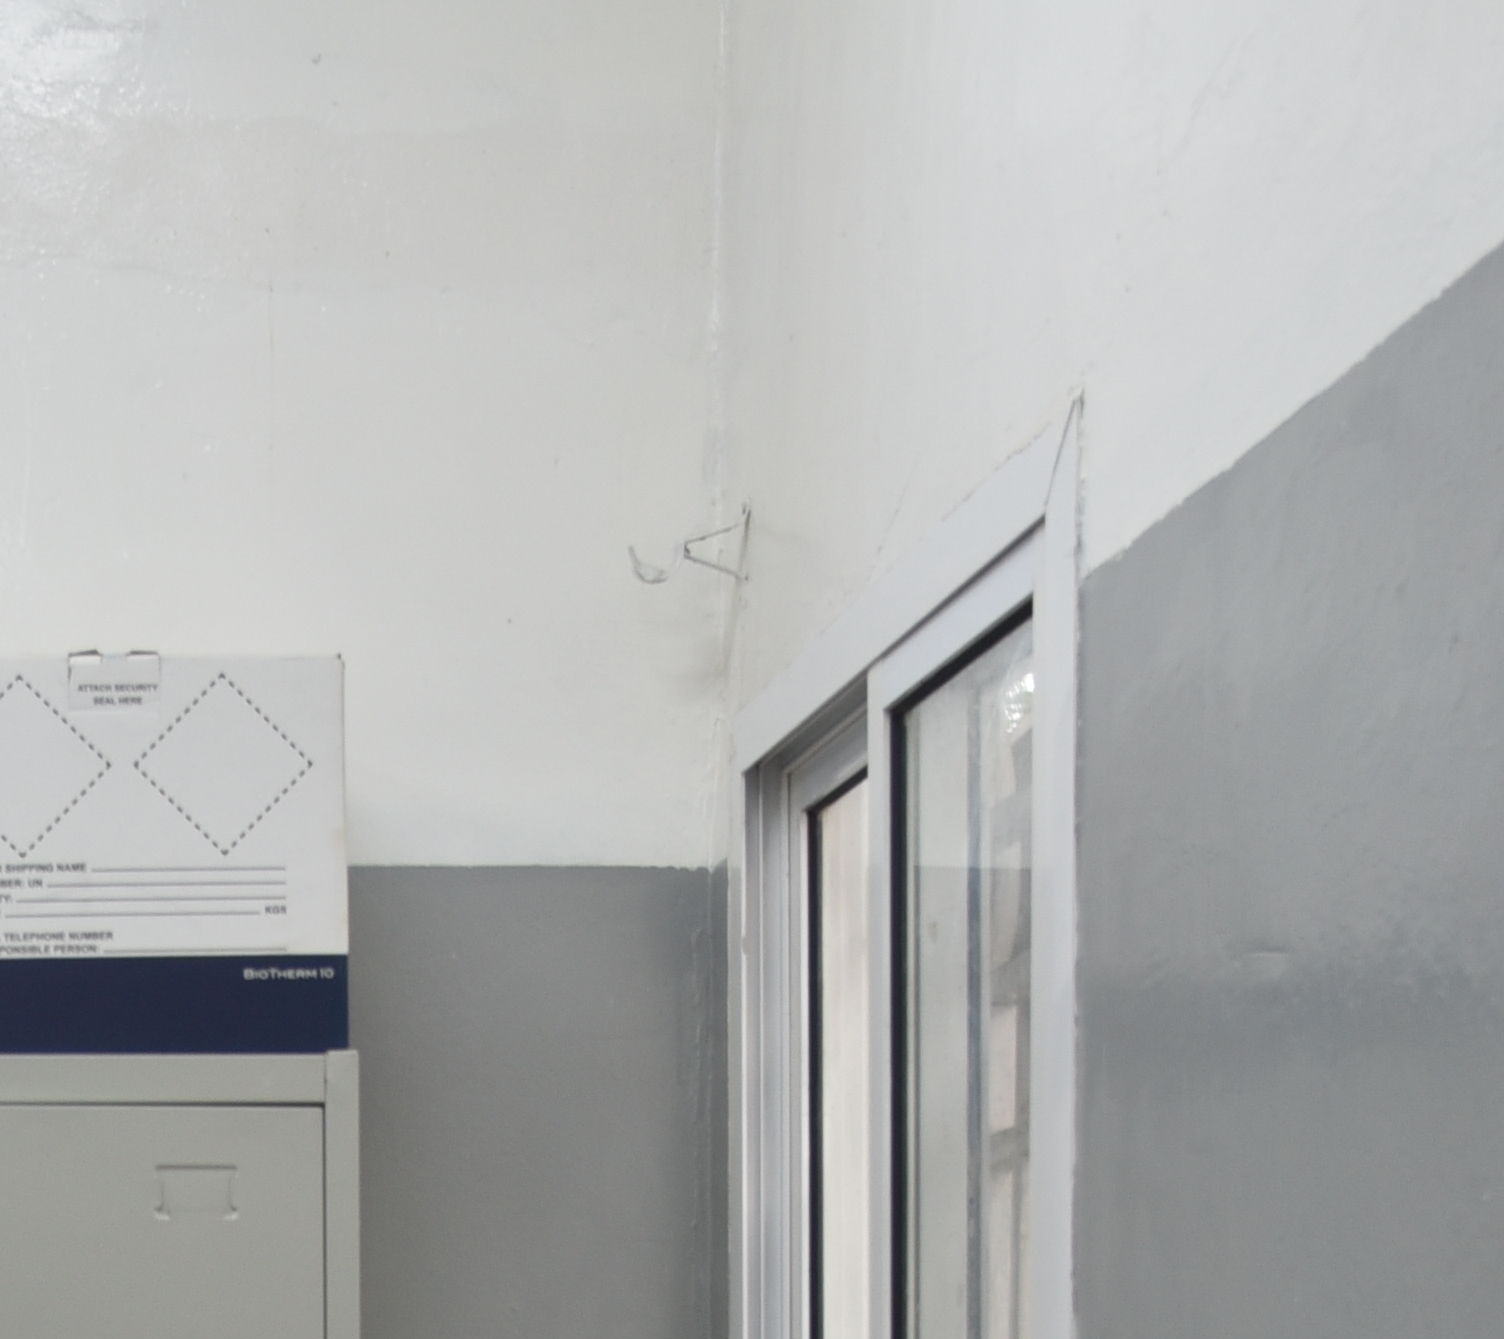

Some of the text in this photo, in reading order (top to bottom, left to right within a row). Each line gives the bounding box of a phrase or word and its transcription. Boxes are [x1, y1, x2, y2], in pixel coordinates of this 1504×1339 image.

[5, 863, 54, 873] SHIPPING
[57, 863, 87, 872] NAME
[28, 879, 43, 888] UN
[4, 932, 65, 942] TELEPHONE
[68, 931, 114, 941] NUMBER
